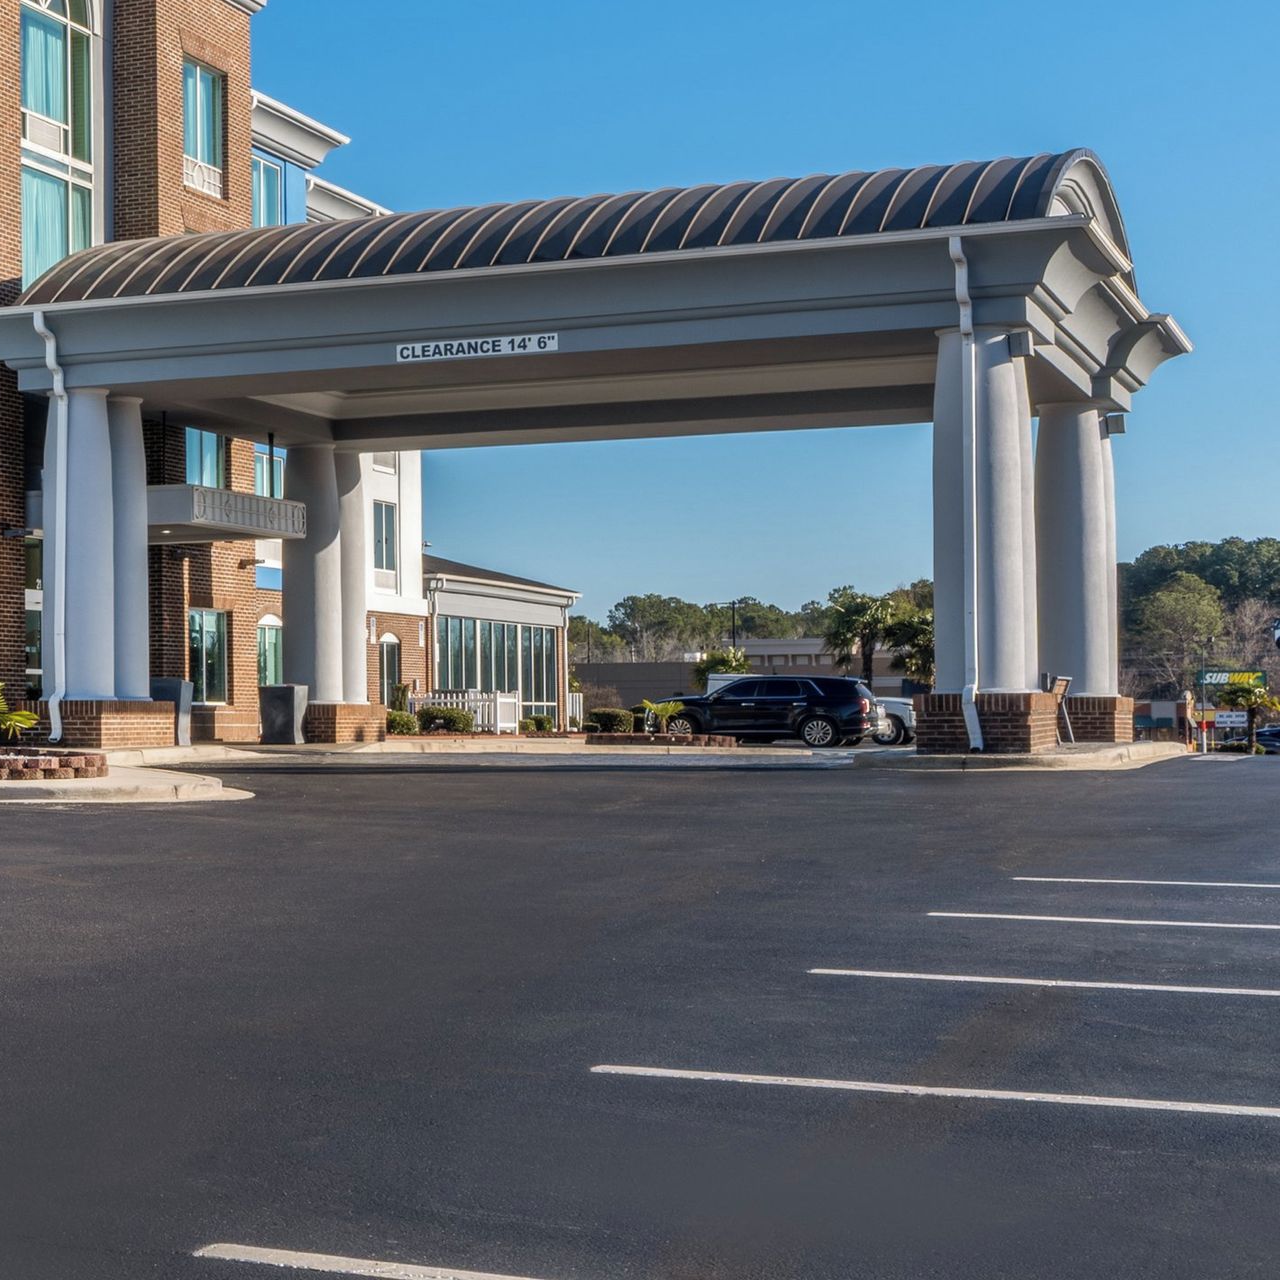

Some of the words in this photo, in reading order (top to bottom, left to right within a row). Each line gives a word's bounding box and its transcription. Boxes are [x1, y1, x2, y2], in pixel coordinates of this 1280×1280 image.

[399, 339, 502, 360] CLEARANCE
[507, 336, 532, 352] 14'
[537, 335, 555, 350] 6"
[1201, 672, 1263, 684] SUBWAY
